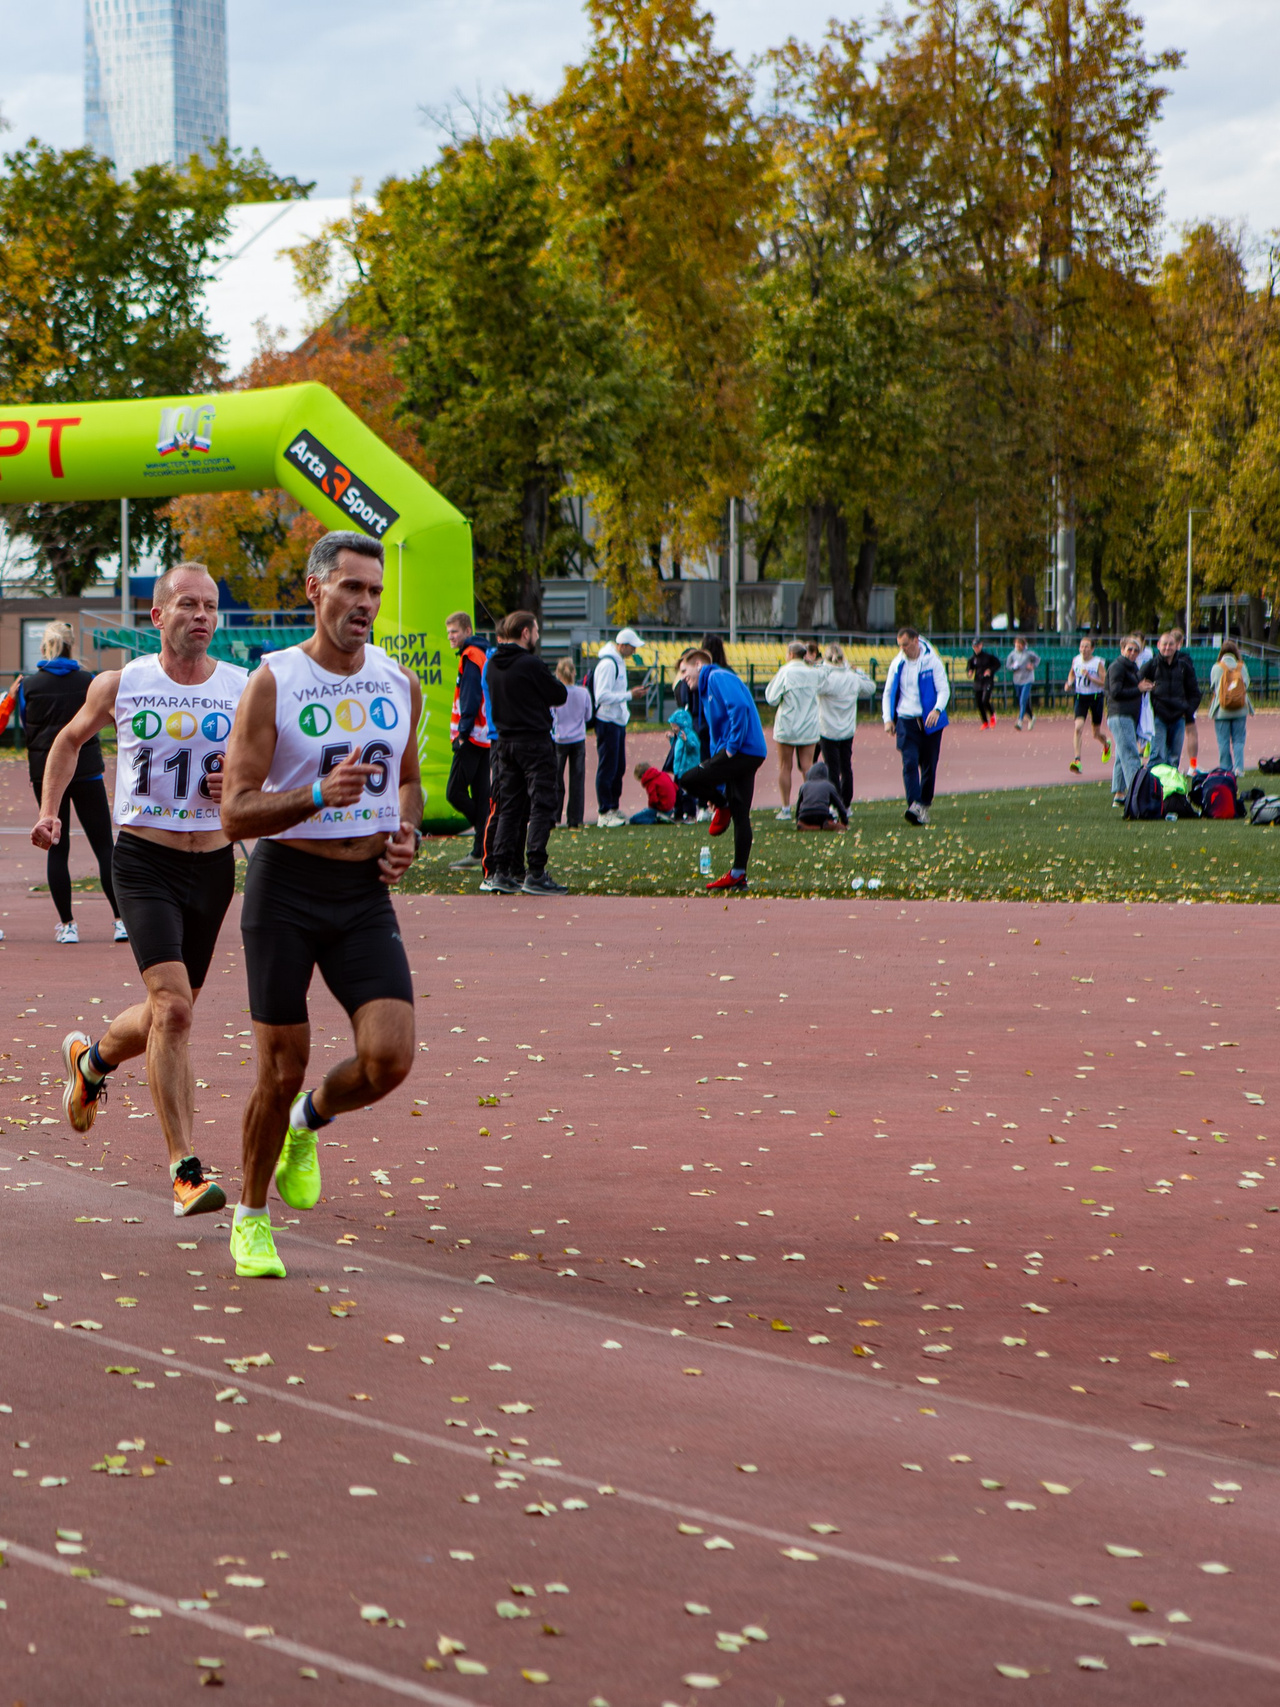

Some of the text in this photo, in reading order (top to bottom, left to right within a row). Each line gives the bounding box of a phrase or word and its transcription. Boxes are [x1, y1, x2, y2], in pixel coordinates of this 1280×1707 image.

[289, 439, 388, 534] Arta Sport
[132, 696, 233, 710] VMARAFONE
[293, 681, 393, 702] VMARAFONE
[132, 747, 226, 800] 118
